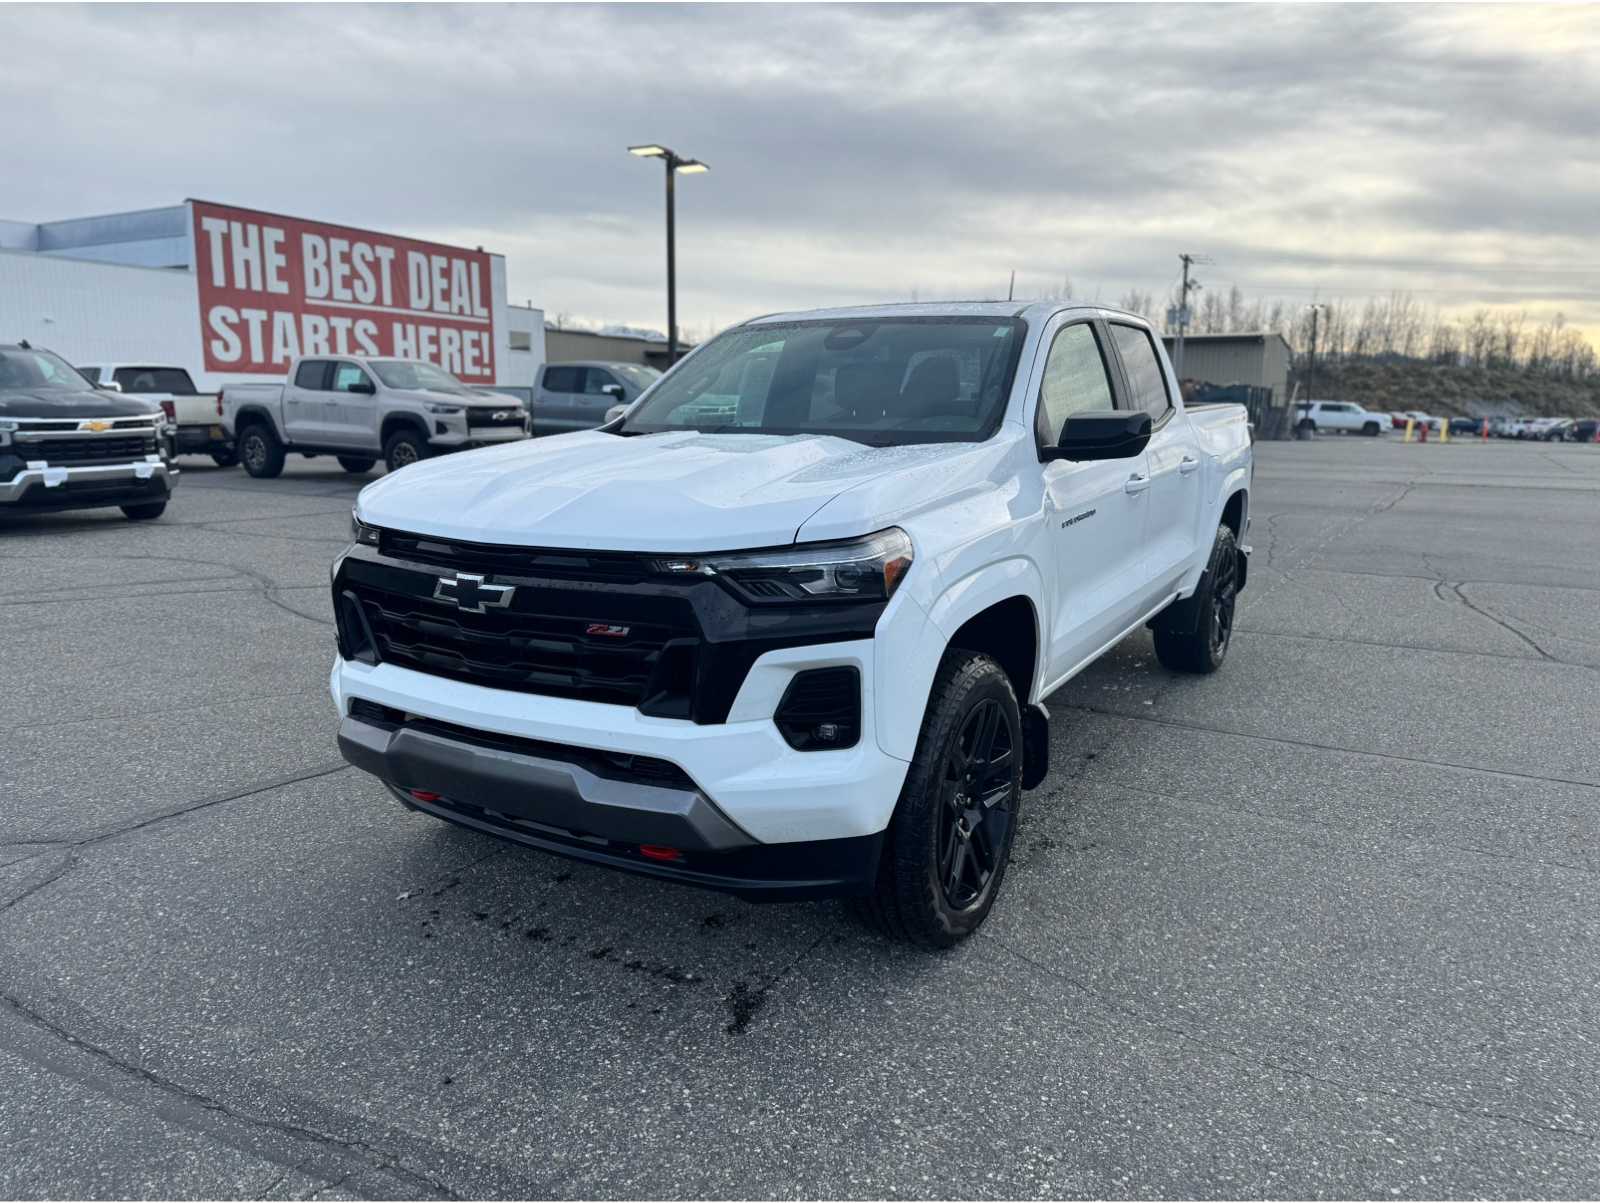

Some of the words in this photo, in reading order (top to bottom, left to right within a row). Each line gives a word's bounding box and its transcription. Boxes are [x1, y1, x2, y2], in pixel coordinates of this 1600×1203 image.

[201, 216, 289, 294] THE
[302, 233, 395, 305] BEST
[408, 251, 489, 317] DEAL
[208, 305, 379, 364] STARTS
[392, 322, 491, 376] HERE!
